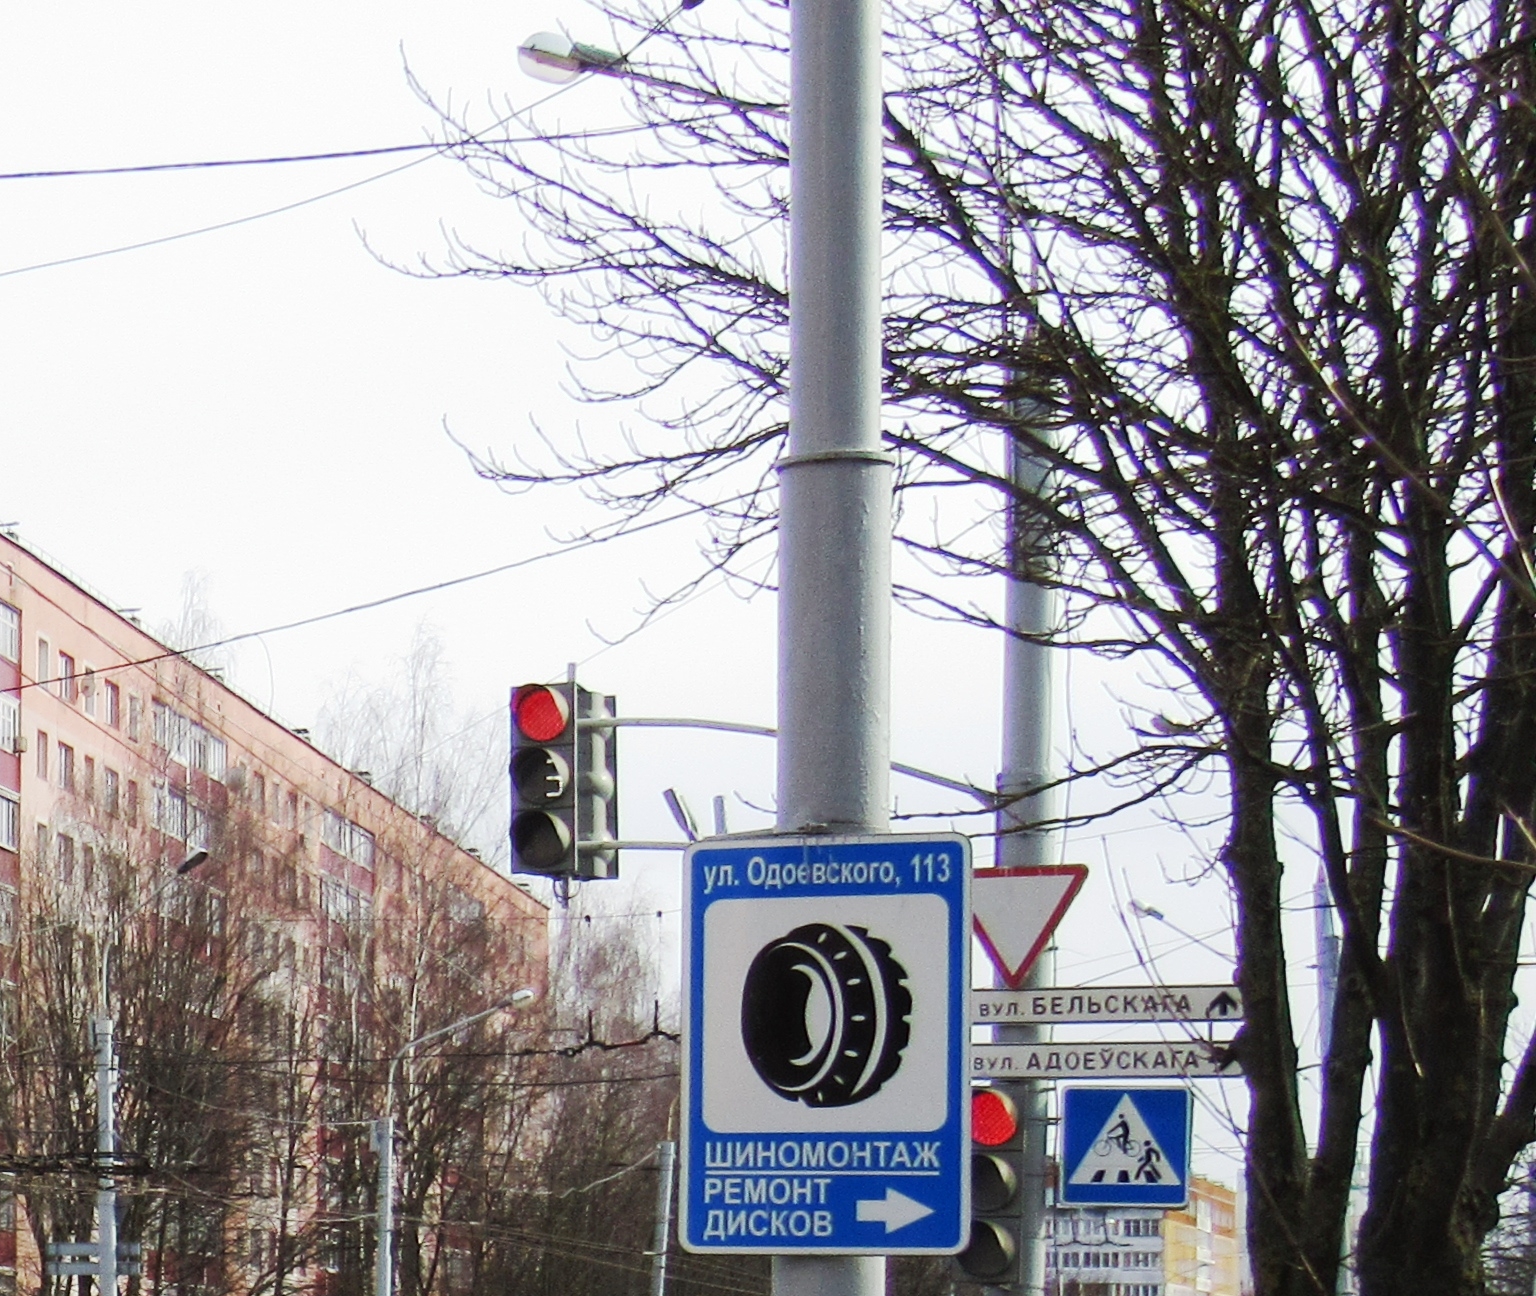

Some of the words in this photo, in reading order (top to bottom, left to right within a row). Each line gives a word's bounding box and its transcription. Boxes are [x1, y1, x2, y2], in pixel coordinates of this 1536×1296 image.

[703, 862, 740, 894] ул.
[746, 856, 902, 890] Одоевского,
[910, 853, 952, 883] 113
[1032, 995, 1192, 1016] БЕЛЬСКАГА
[1026, 1048, 1199, 1072] АДОЕЎСКАГА
[705, 1141, 941, 1169] ШИНОМОНТАЖ
[703, 1178, 832, 1205] РЕМОНТ
[703, 1209, 833, 1242] ДИСКОВ
